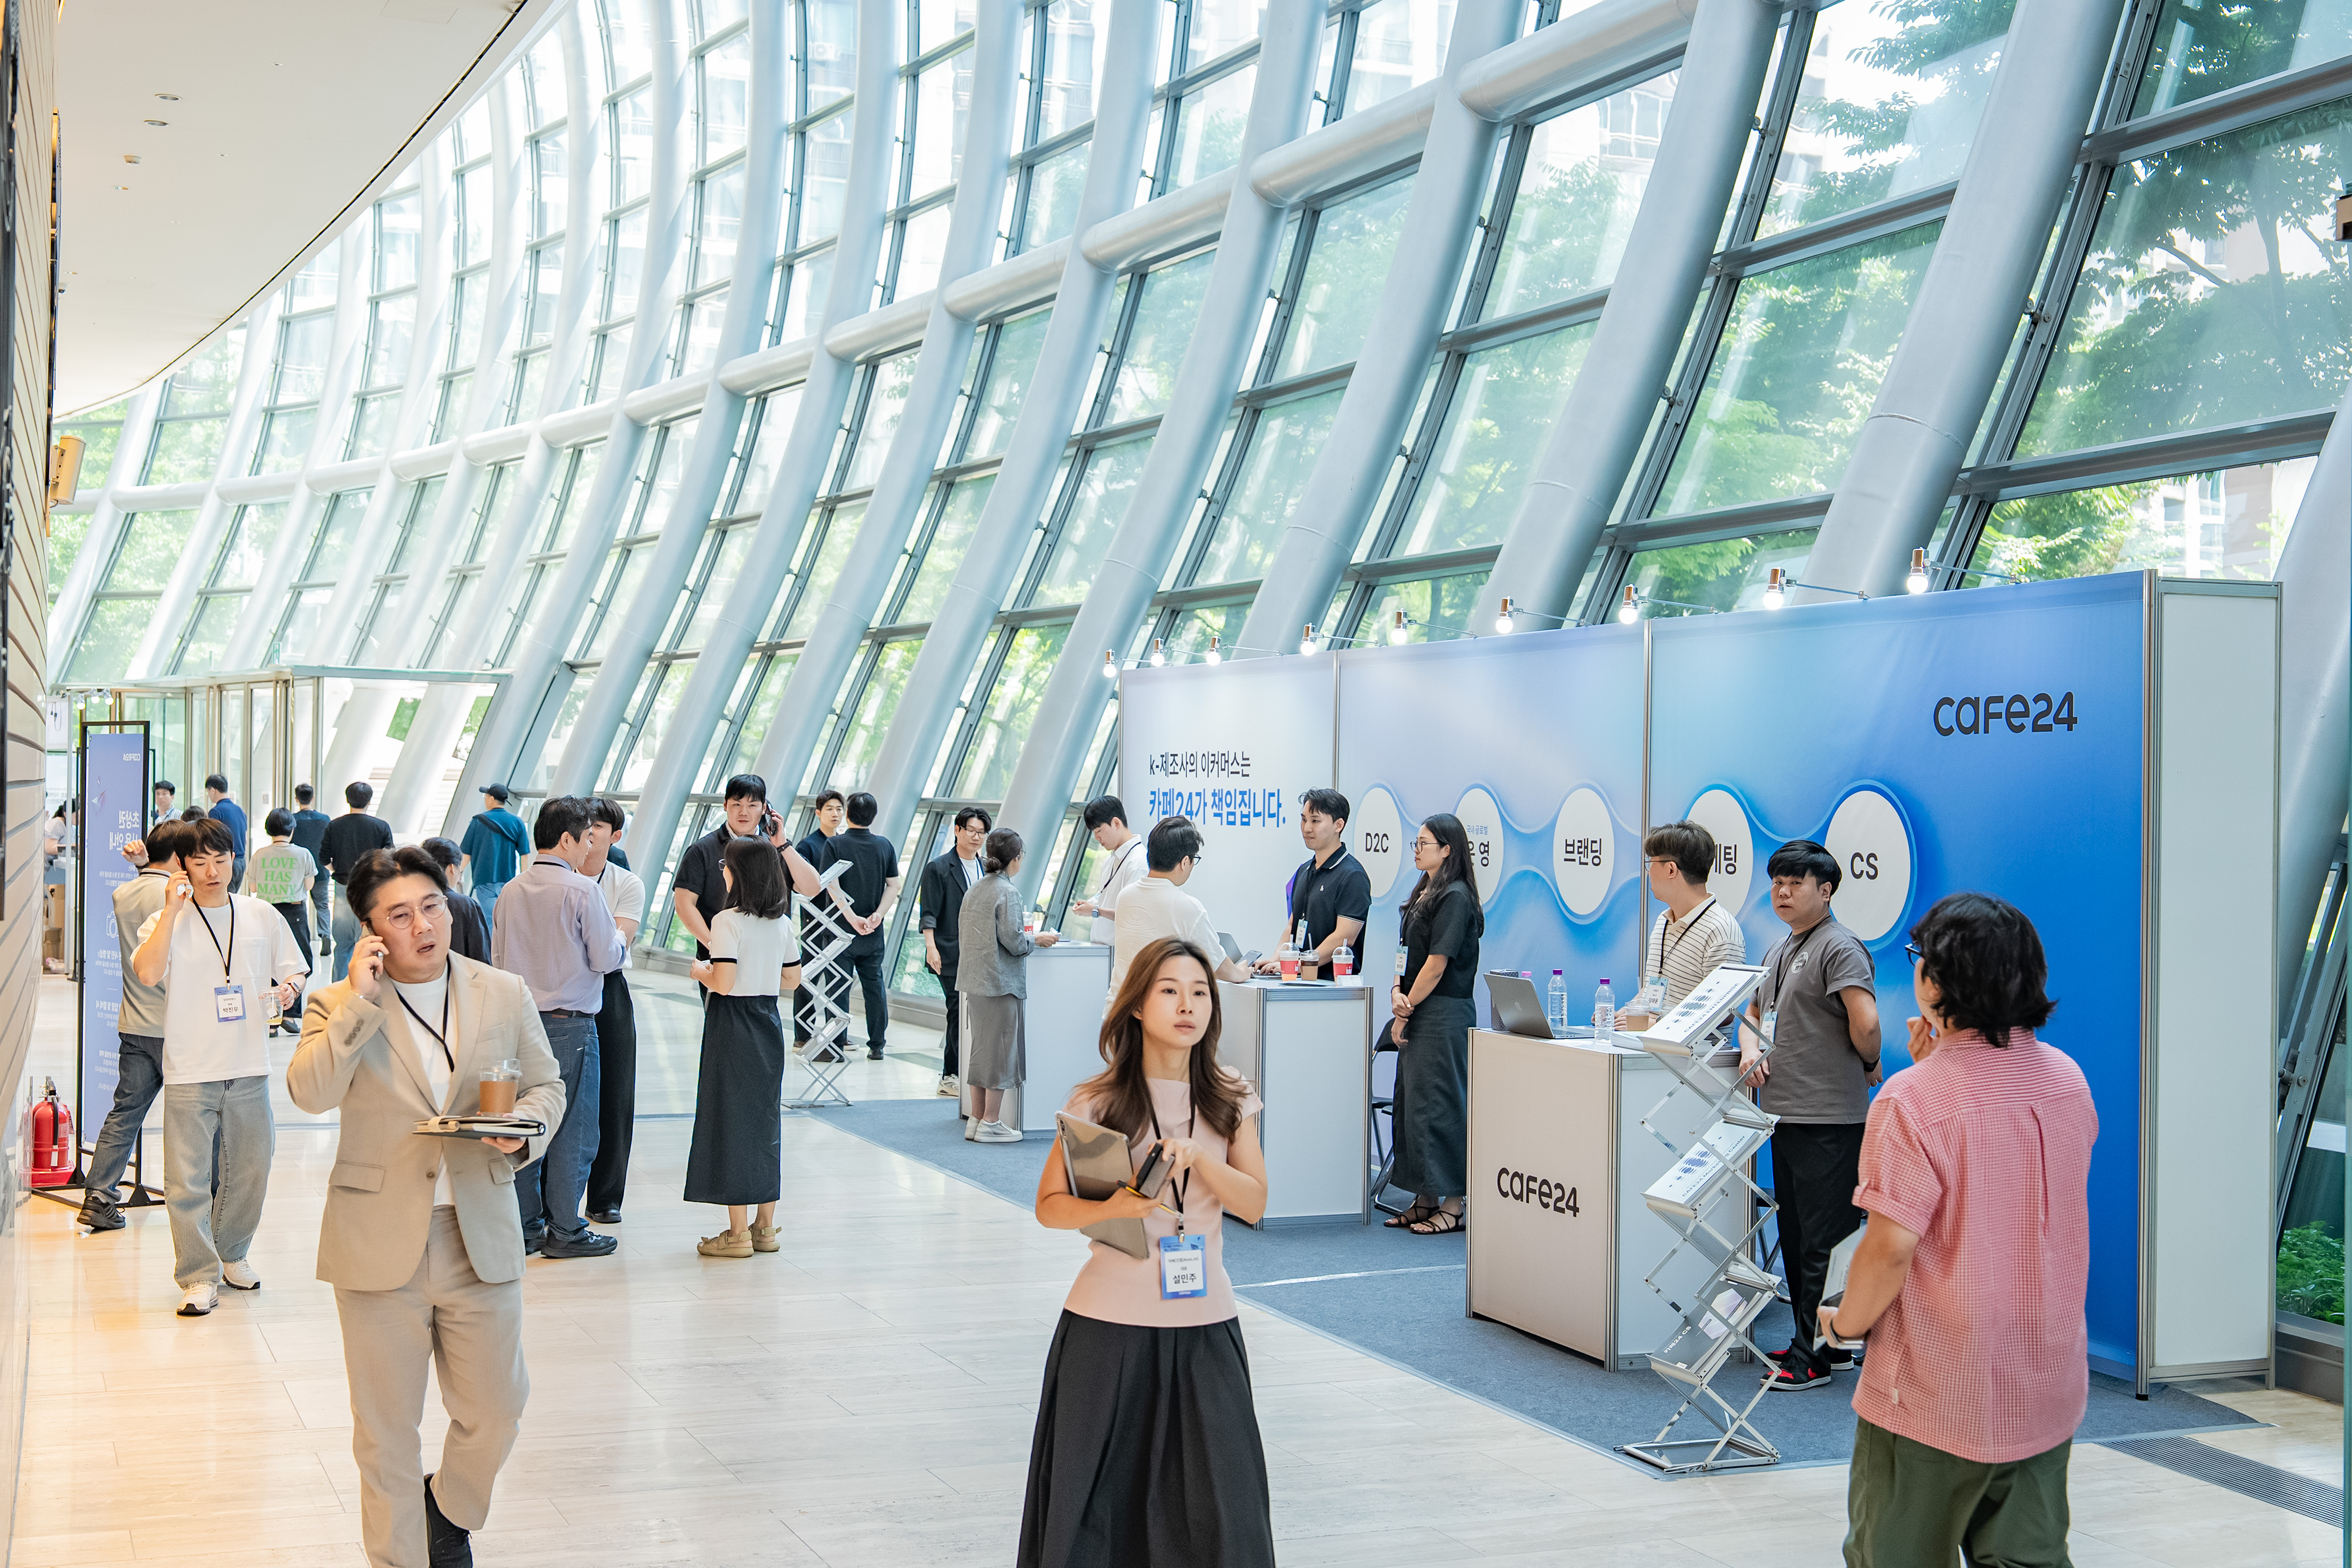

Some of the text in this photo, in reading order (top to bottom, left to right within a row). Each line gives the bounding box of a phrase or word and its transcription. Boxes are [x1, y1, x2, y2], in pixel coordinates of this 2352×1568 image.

[1149, 751, 1251, 778] k-제조사의 이커머스는
[1149, 788, 1286, 828] 카페24가 책임집니다.
[1365, 833, 1389, 853] D2C
[1564, 838, 1602, 867] 브랜딩
[261, 857, 298, 870] LOVE
[264, 871, 292, 883] HAS
[1850, 852, 1878, 880] CS
[257, 883, 297, 895] MANY
[1684, 1014, 1707, 1033] CAFE24
[1706, 982, 1740, 1013] ENTERPRISE
[1682, 1178, 1704, 1197] CAFE24
[1728, 1135, 1745, 1152] Center
[1173, 1273, 1196, 1284] 설민주
